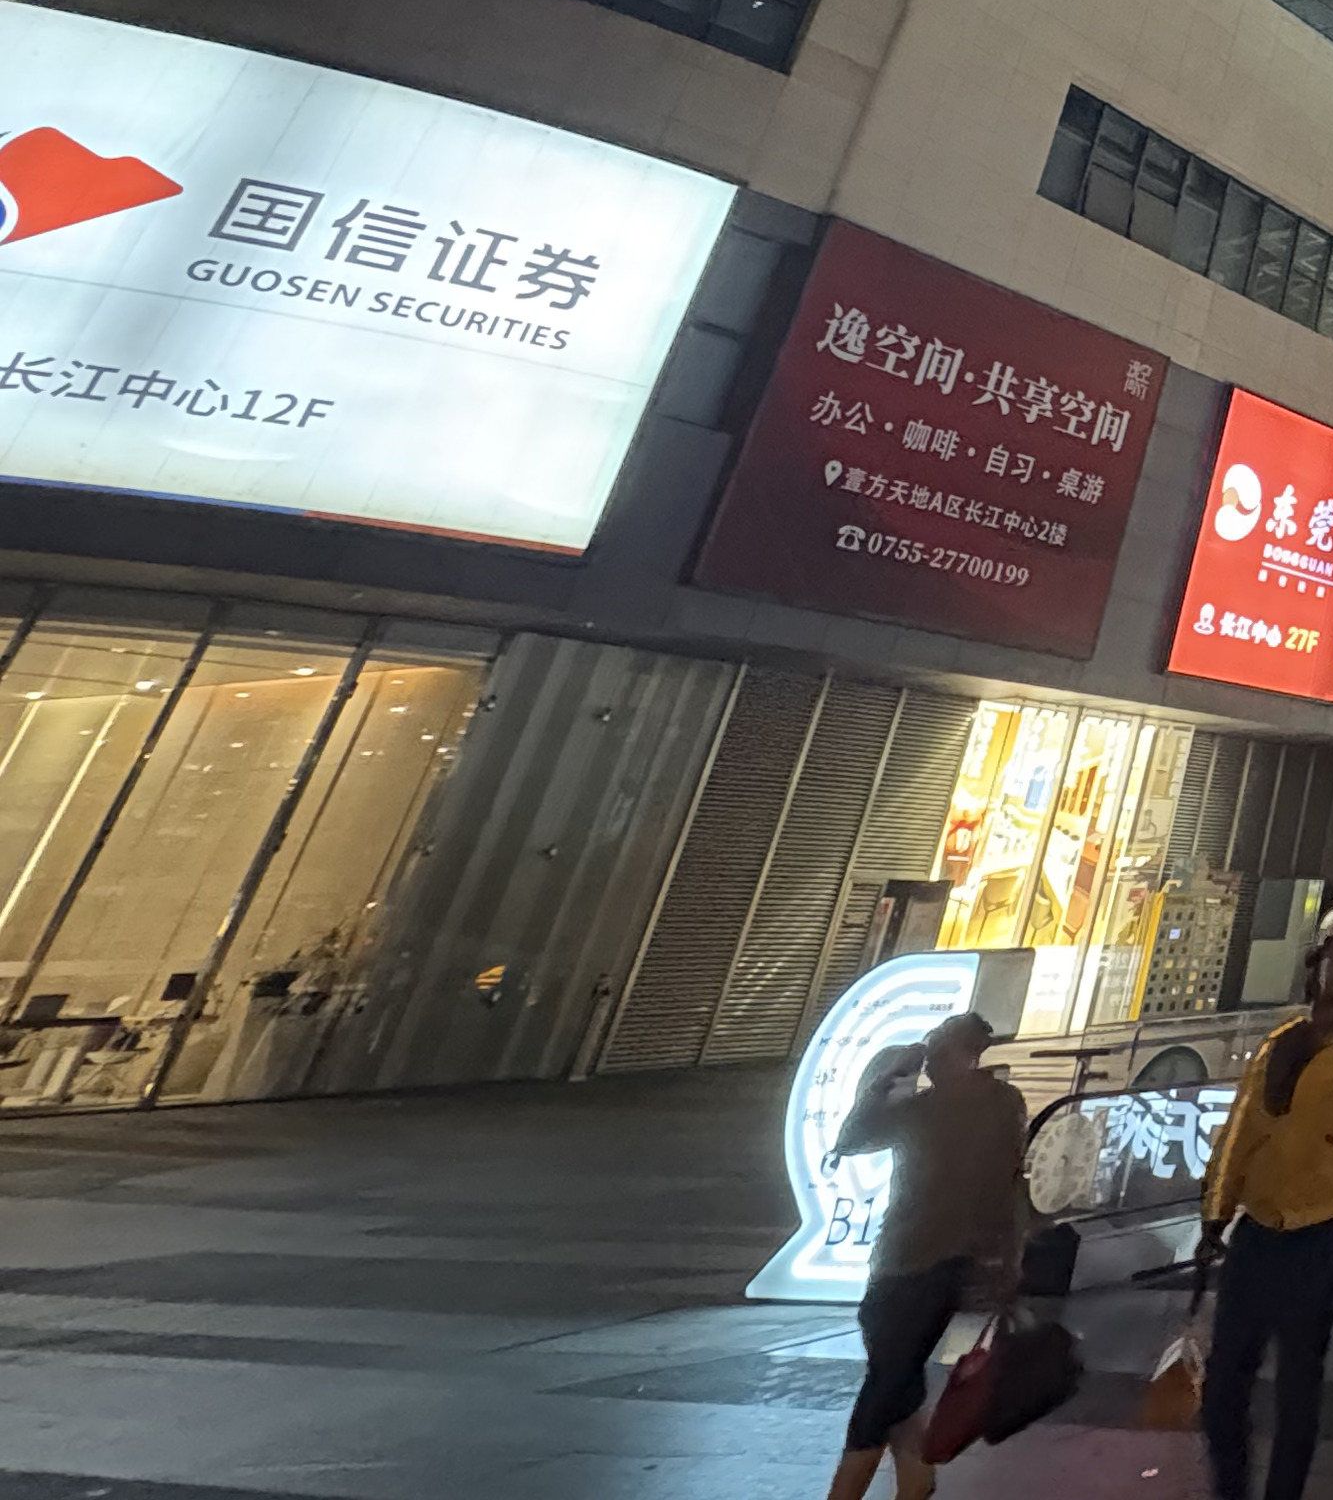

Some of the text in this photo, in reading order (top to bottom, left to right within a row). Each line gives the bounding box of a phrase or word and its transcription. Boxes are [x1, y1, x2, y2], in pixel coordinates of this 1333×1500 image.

[207, 177, 601, 311] 国信证券
[186, 257, 571, 352] GUOSEN SECURITIES
[0, 351, 335, 429] 长江中心12F
[866, 534, 1030, 588] 0755-27700199
[1284, 625, 1321, 654] 27F
